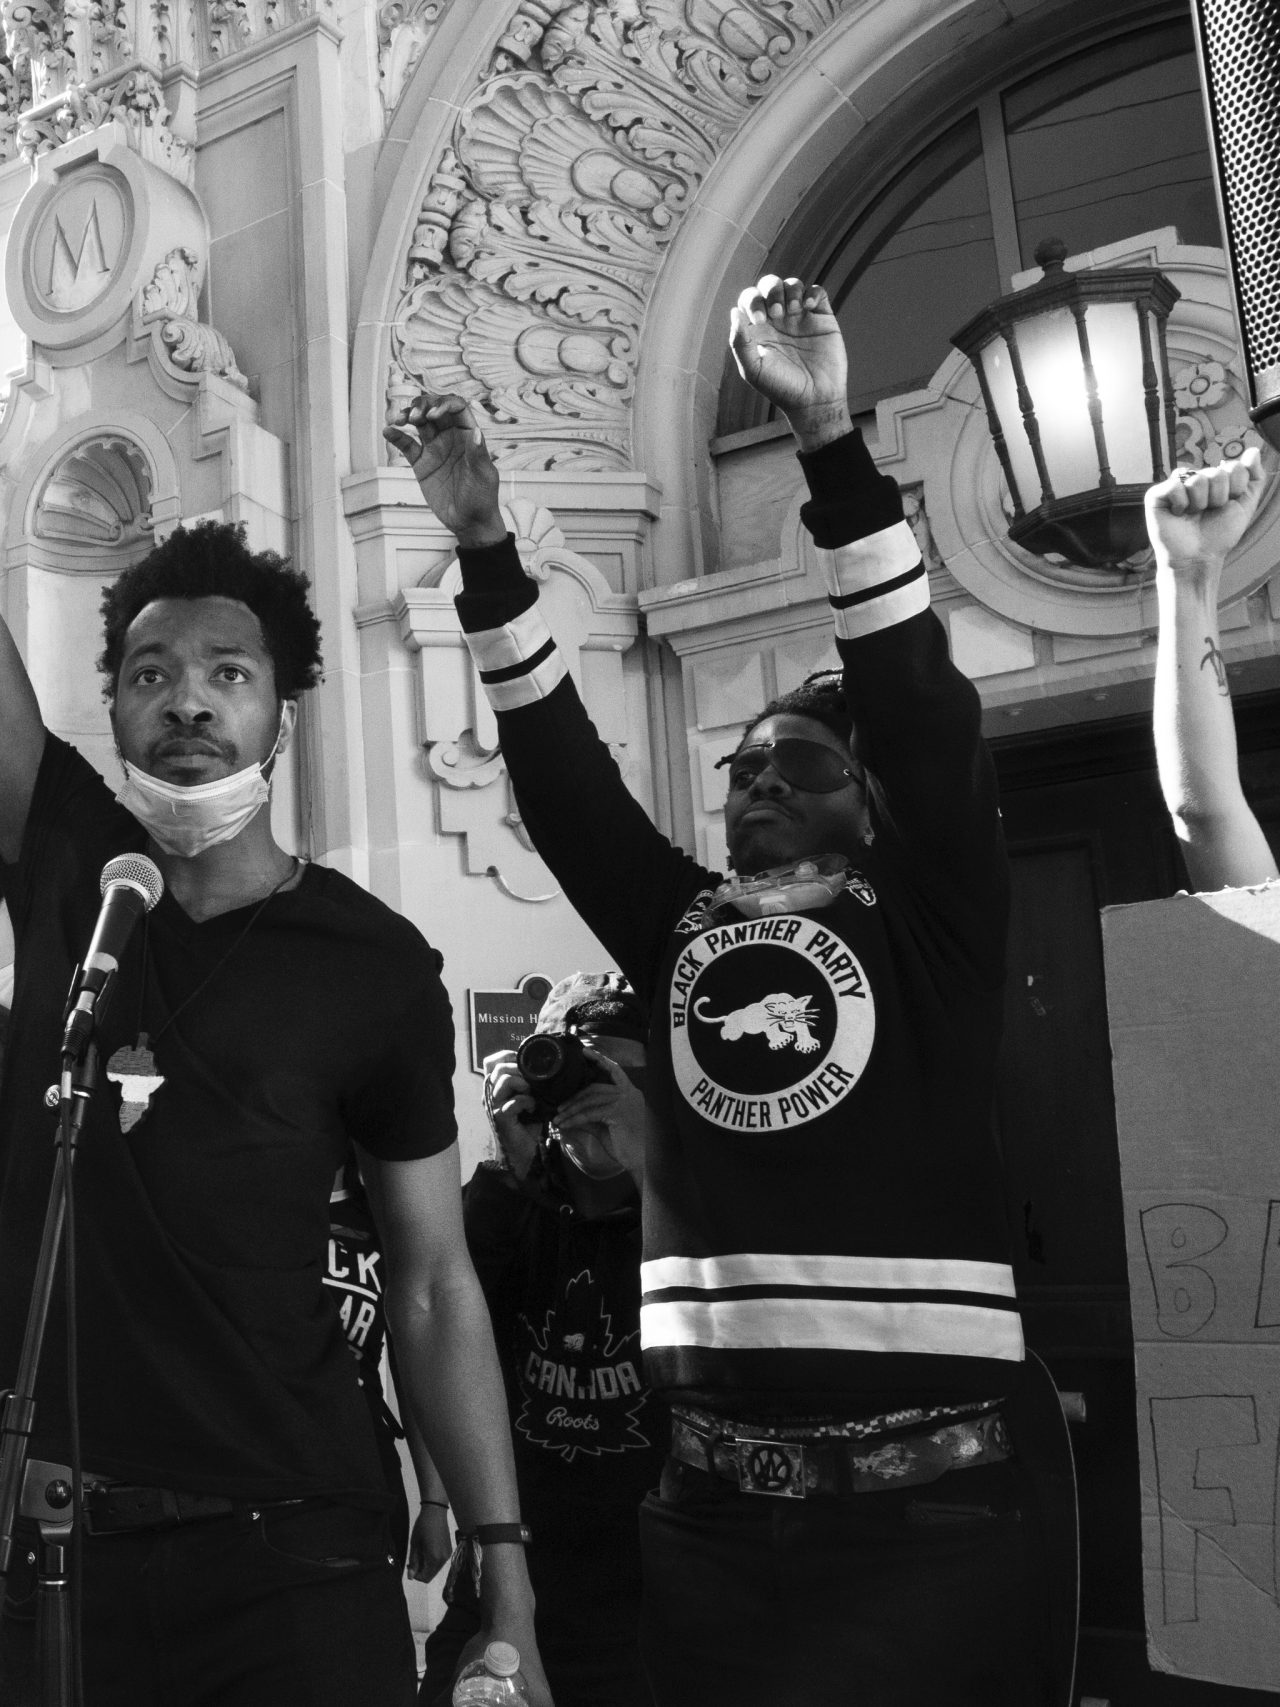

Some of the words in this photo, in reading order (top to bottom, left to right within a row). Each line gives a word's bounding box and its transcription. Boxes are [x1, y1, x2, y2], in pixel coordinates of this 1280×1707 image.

[46, 198, 110, 297] M
[672, 949, 704, 1029] BLACK
[704, 918, 803, 955] PANTHER
[804, 929, 867, 1000] PARTY
[478, 1013, 524, 1023] Mission
[529, 1013, 540, 1023] H
[690, 1077, 773, 1129] PANTHER
[777, 1061, 855, 1125] POWER
[328, 1238, 382, 1294] CK
[545, 1406, 600, 1431] Roots
